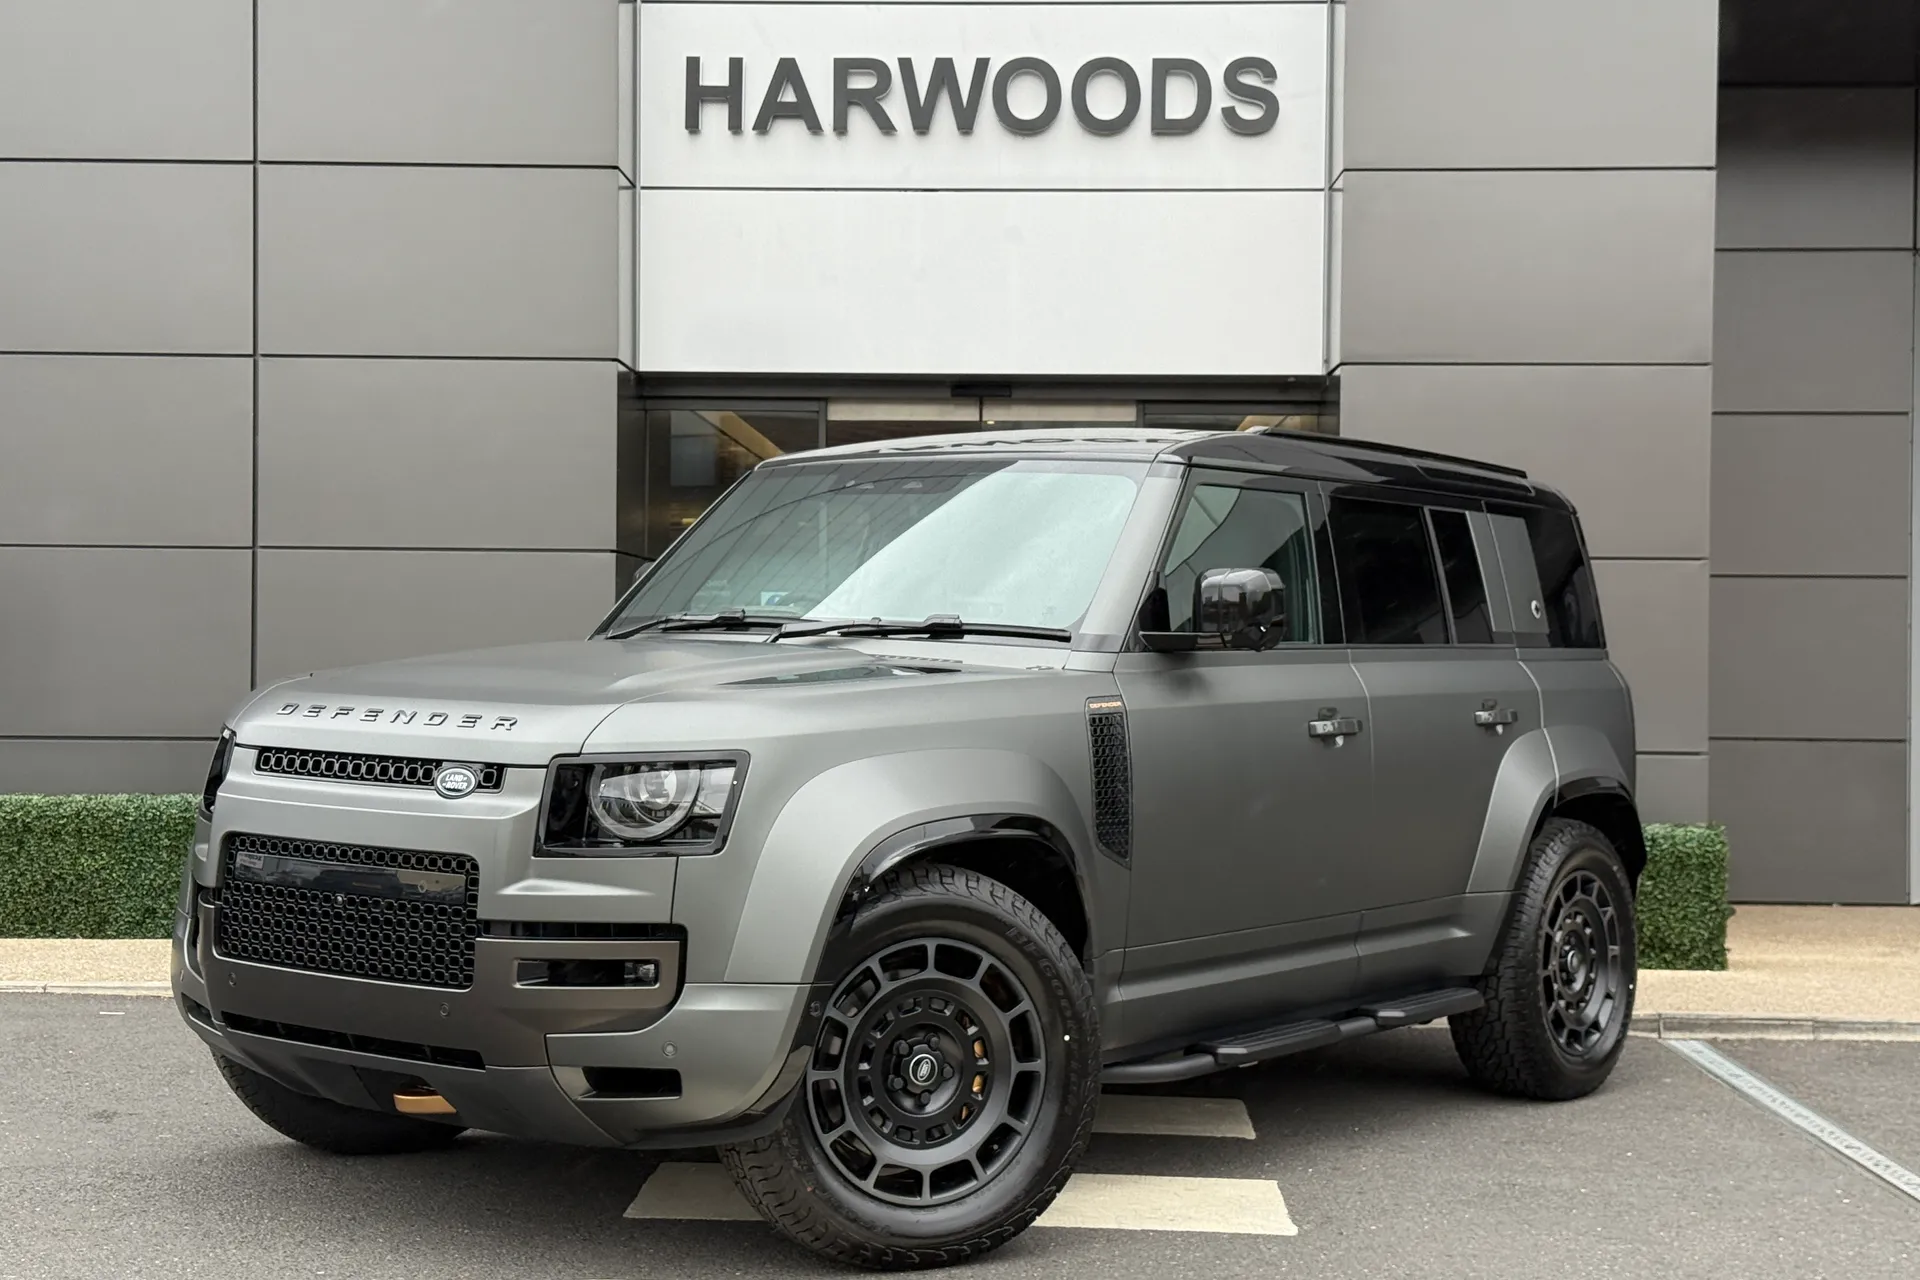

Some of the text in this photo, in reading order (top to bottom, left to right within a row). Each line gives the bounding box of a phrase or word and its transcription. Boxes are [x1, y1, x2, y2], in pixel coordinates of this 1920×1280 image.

[685, 56, 1279, 136] HARWOODS
[276, 703, 518, 731] DEFENDER
[445, 774, 463, 782] LAND
[446, 781, 467, 789] ROVER
